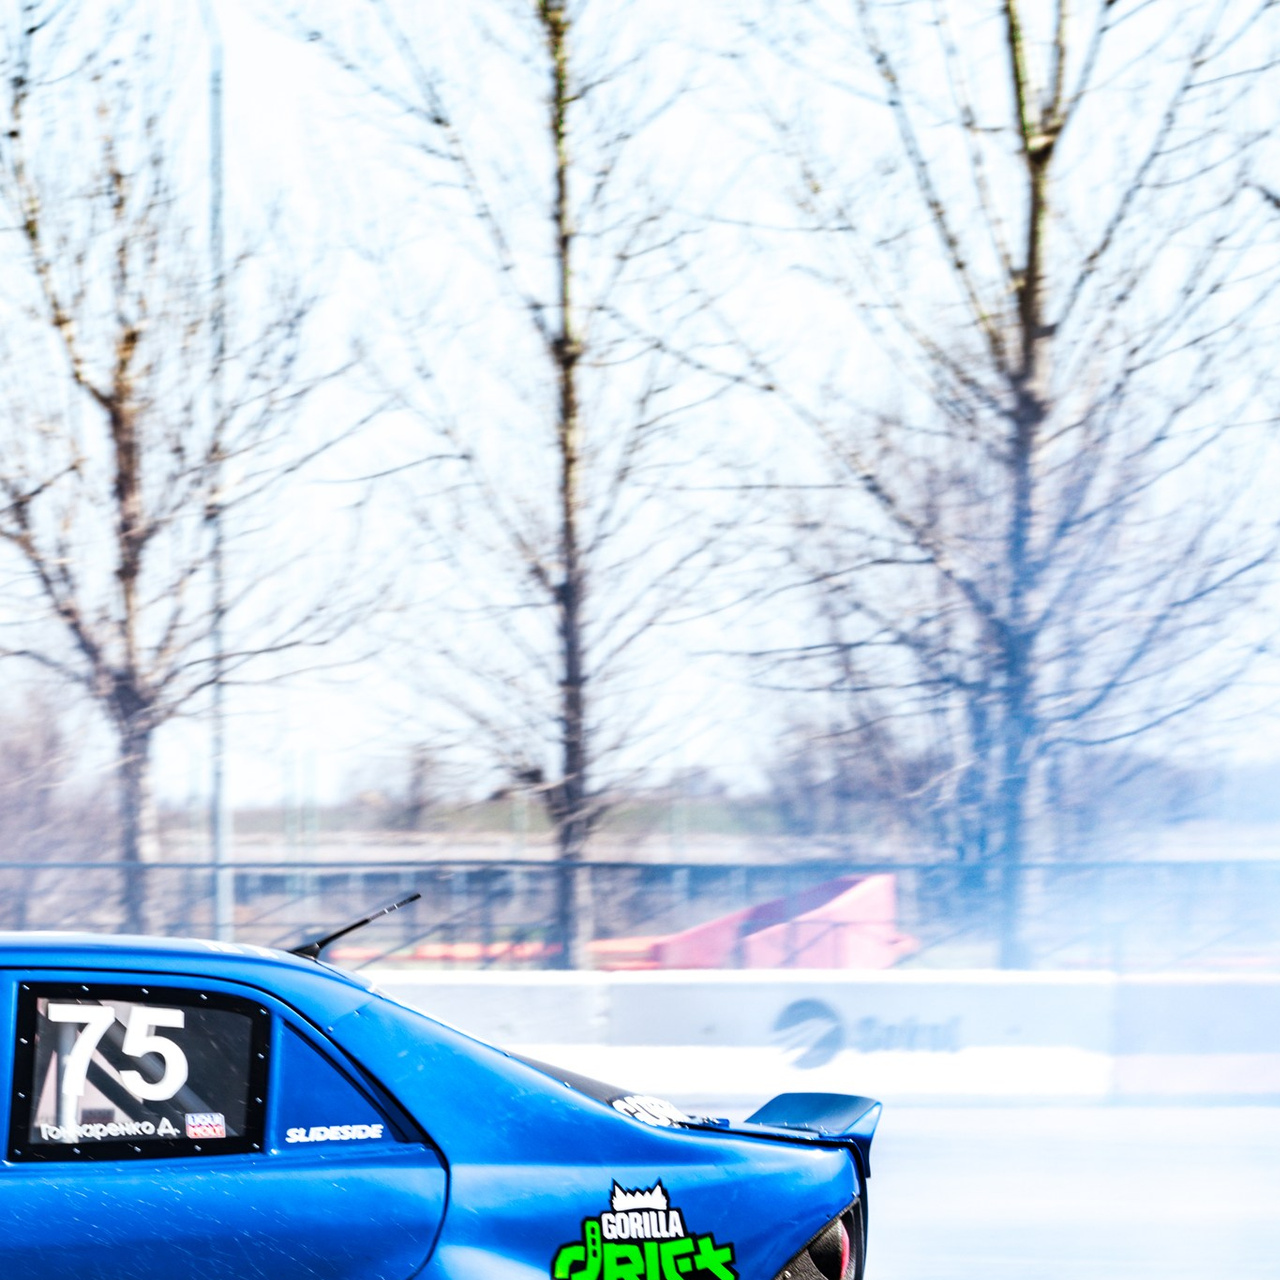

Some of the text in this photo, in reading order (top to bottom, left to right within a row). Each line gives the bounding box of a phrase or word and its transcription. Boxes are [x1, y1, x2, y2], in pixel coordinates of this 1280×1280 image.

[47, 1003, 189, 1101] 75
[39, 1120, 156, 1141] Гоаренко
[285, 1123, 384, 1143] SLIDESIDE
[601, 1210, 685, 1239] GORILLA
